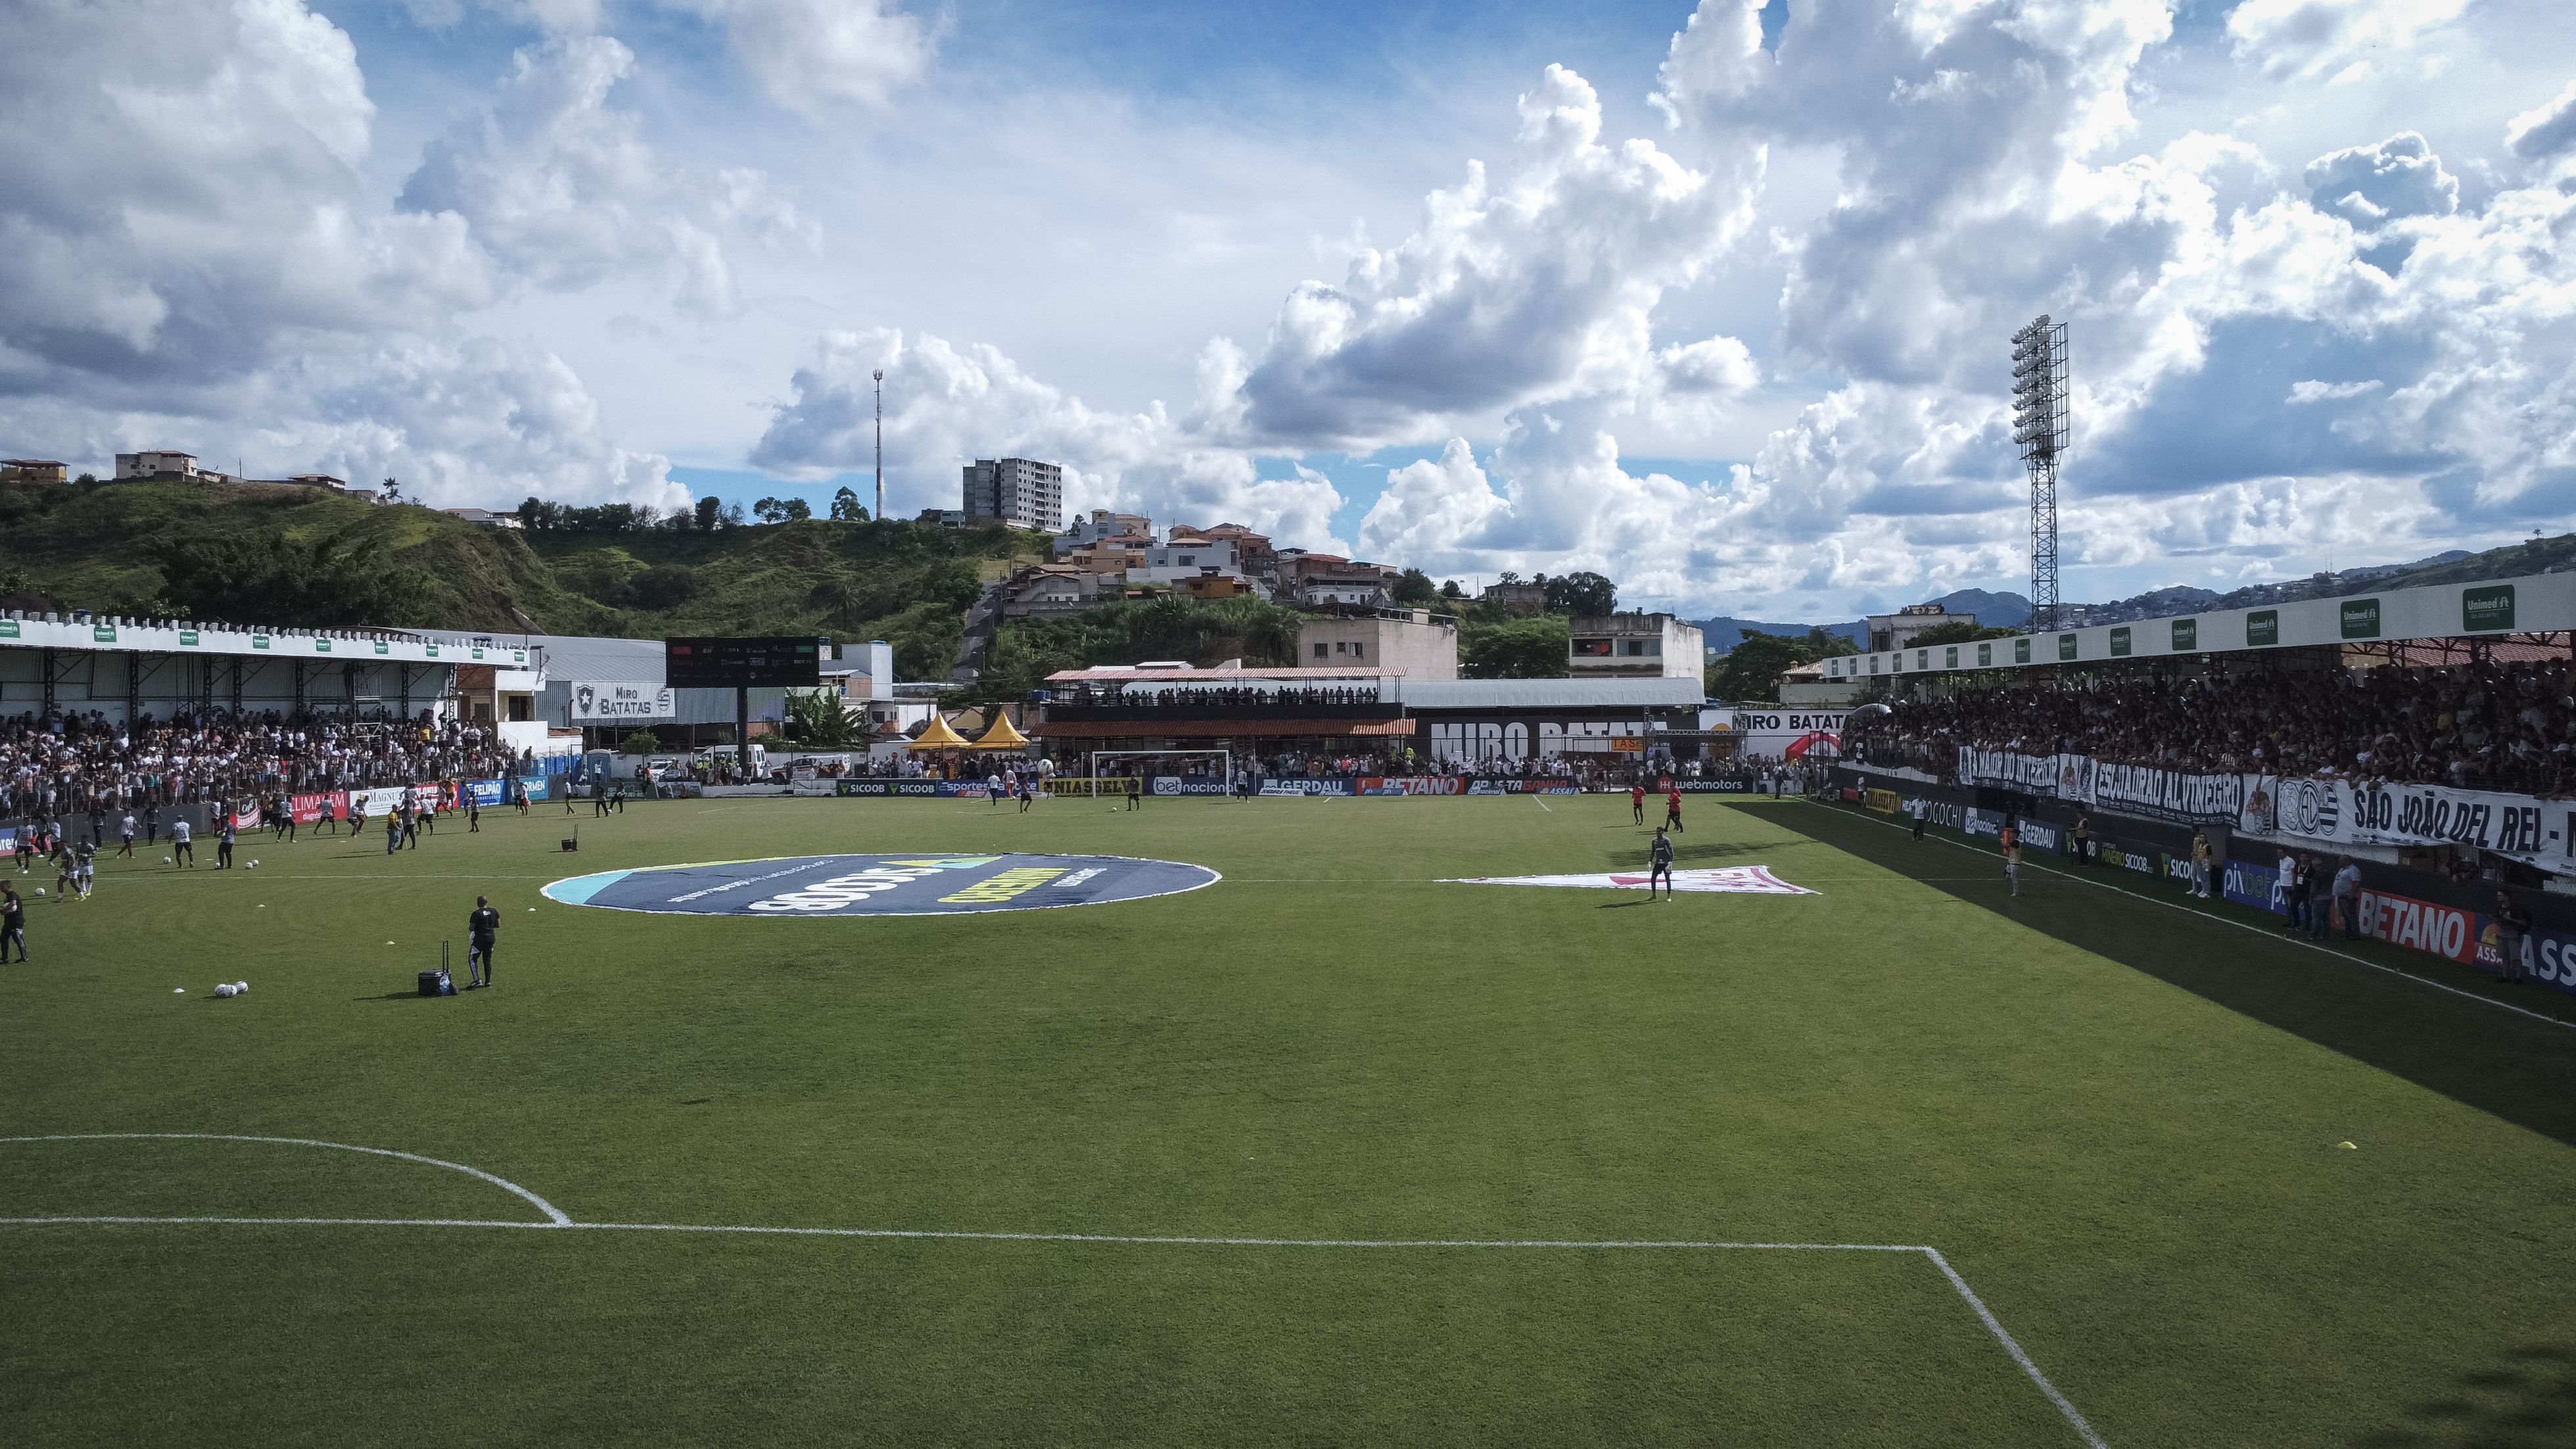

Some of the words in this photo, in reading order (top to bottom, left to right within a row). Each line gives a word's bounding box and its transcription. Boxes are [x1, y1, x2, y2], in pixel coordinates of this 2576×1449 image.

[2468, 597, 2497, 611] Unimed
[2344, 609, 2367, 621] Unimed
[2249, 619, 2268, 629] Unimed
[617, 687, 638, 699] MIRO
[601, 698, 651, 715] BATATAS
[1979, 750, 2003, 779] MAIOR
[2003, 751, 2015, 780] DO
[2016, 753, 2058, 787] INTERIOR
[474, 780, 501, 796] FELIPÃO
[850, 784, 885, 793] SICOOB
[899, 784, 935, 793] SICOOB
[939, 782, 989, 793] Esportes
[1280, 780, 1342, 792] GERDAU
[1382, 778, 1459, 795] BETANO
[1675, 778, 1743, 789] webmotors
[2163, 771, 2241, 816] ALVINEGRO
[2398, 790, 2450, 840] JOÃO
[2448, 802, 2491, 848] DEL
[2496, 806, 2541, 852] REI
[2025, 824, 2055, 849] GERDAU
[2072, 836, 2096, 857] SIOB
[2125, 853, 2147, 872] SICOOB
[2170, 858, 2193, 880] SICO
[2358, 891, 2466, 959] BETANO
